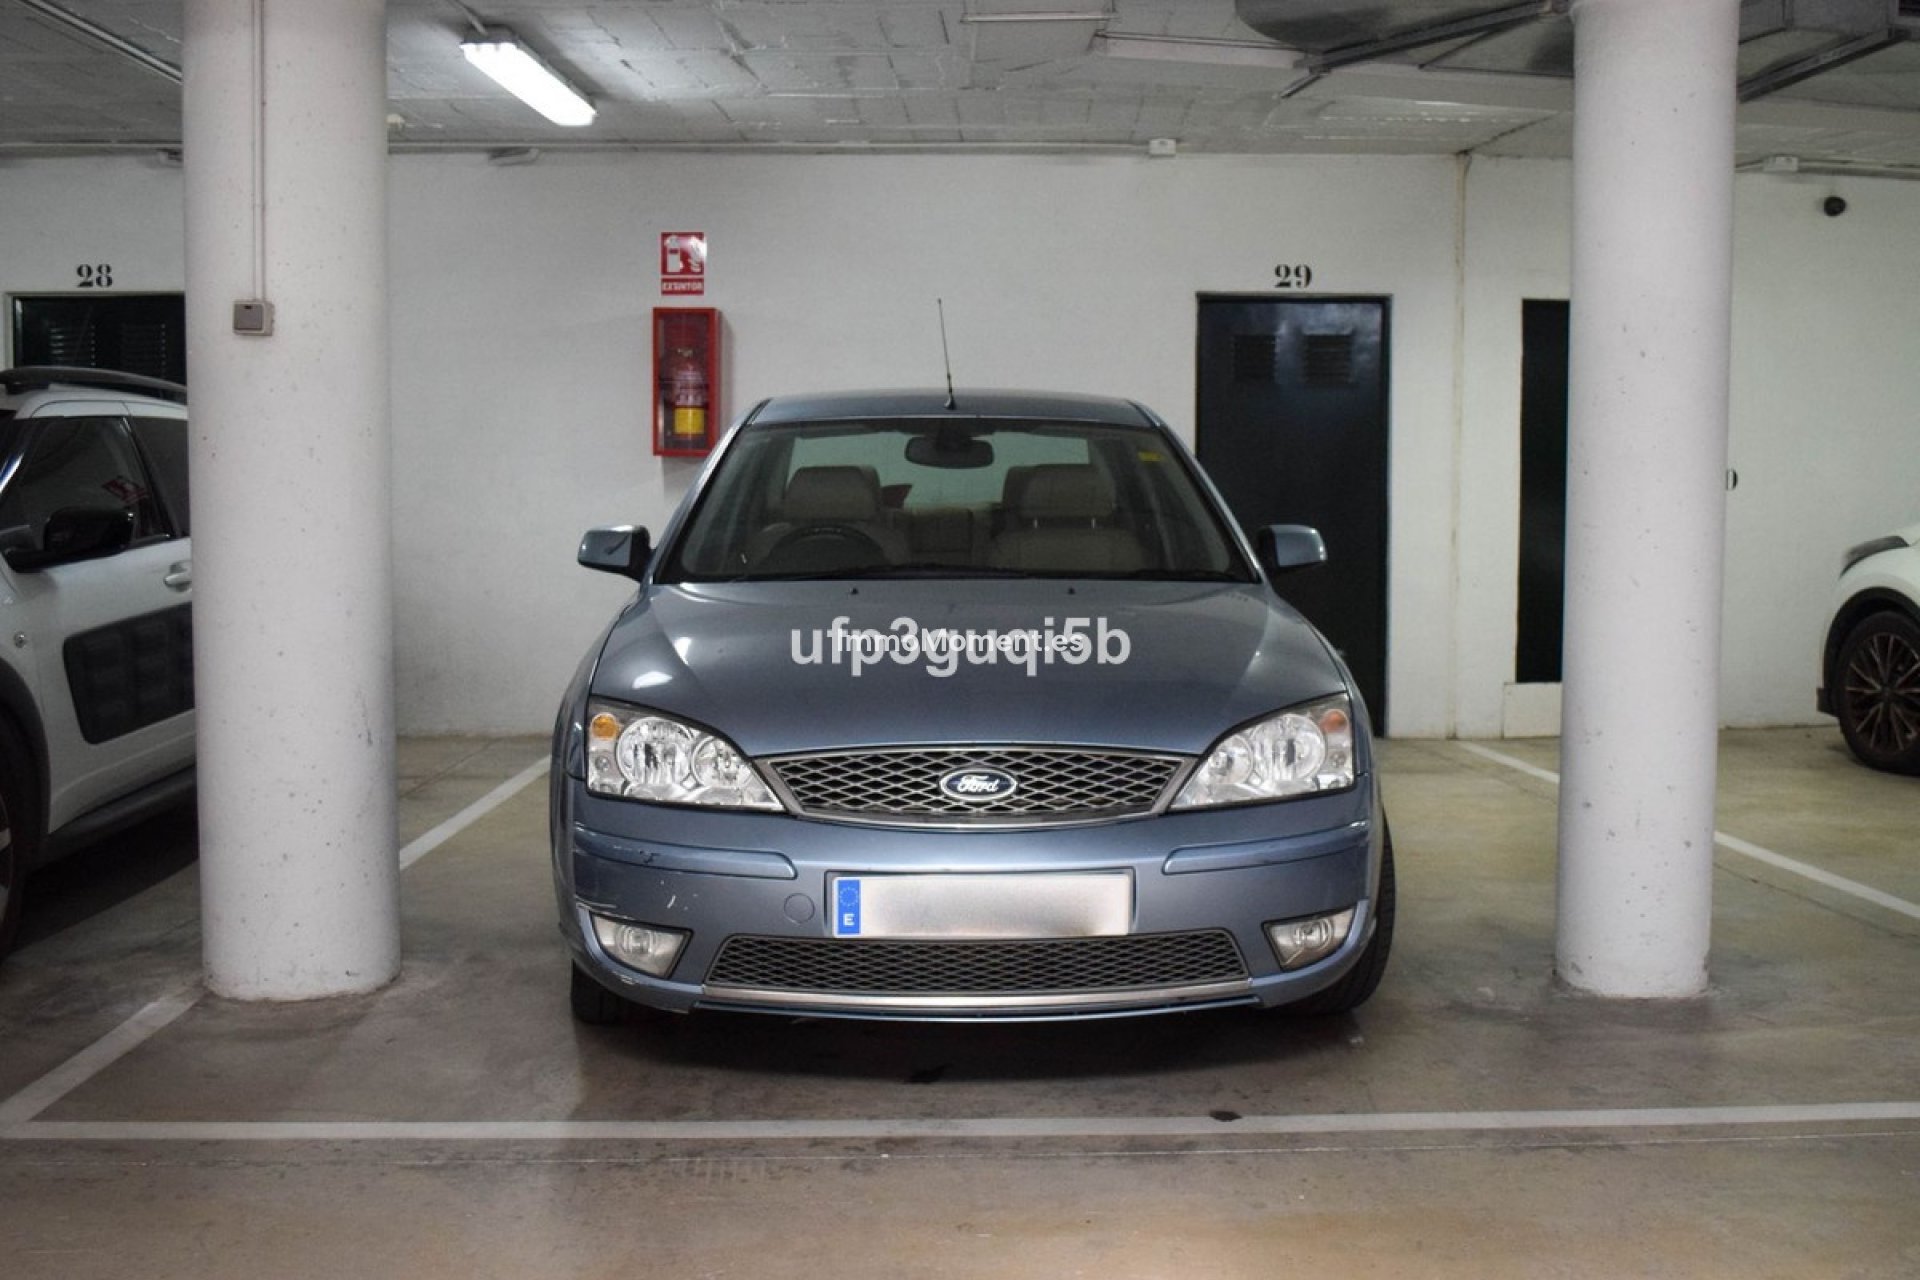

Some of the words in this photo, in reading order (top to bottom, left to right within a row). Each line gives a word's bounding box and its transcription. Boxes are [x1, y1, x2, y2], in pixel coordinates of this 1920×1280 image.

[76, 263, 112, 288] 28
[1274, 264, 1312, 288] 29
[957, 774, 999, 792] Ford
[844, 914, 855, 926] E
